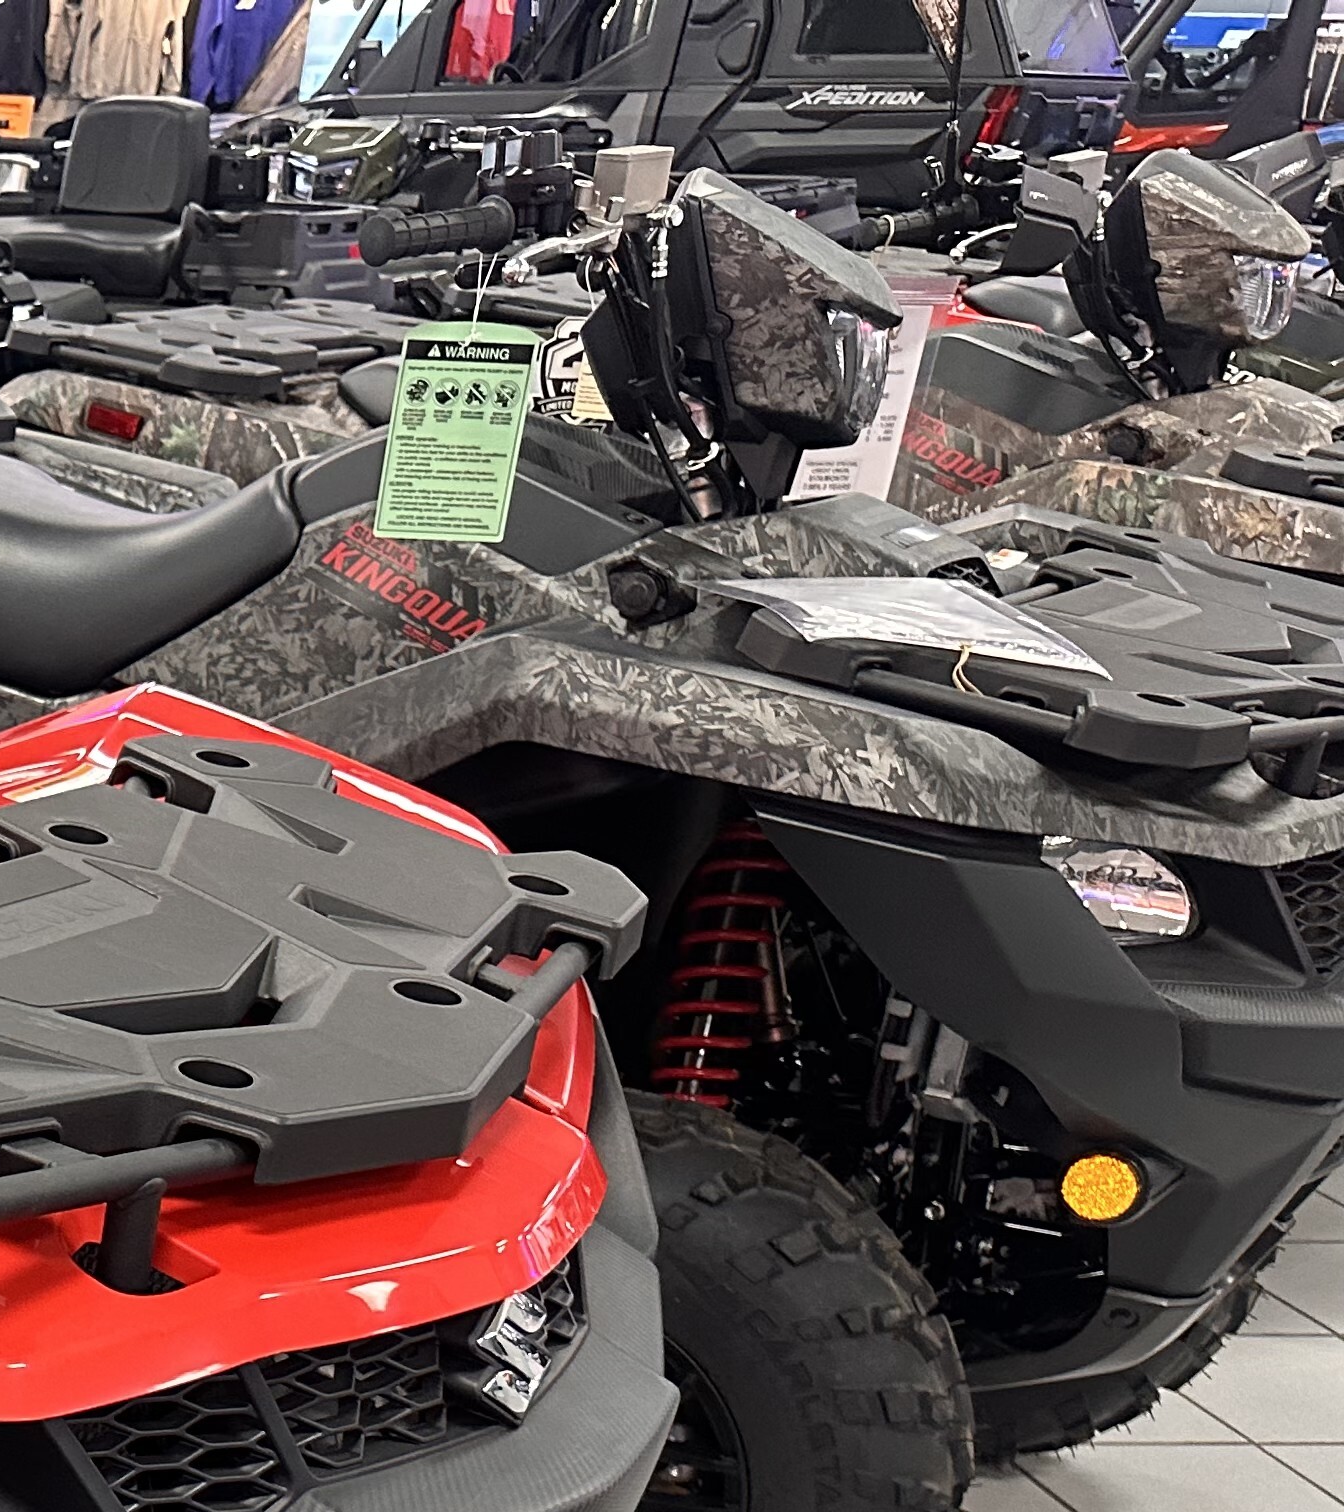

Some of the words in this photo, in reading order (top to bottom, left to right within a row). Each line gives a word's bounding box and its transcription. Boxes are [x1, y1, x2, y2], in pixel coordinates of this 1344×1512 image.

[785, 84, 926, 110] XPEDITION
[445, 345, 510, 361] WARNING
[322, 541, 488, 641] KINGQUA
